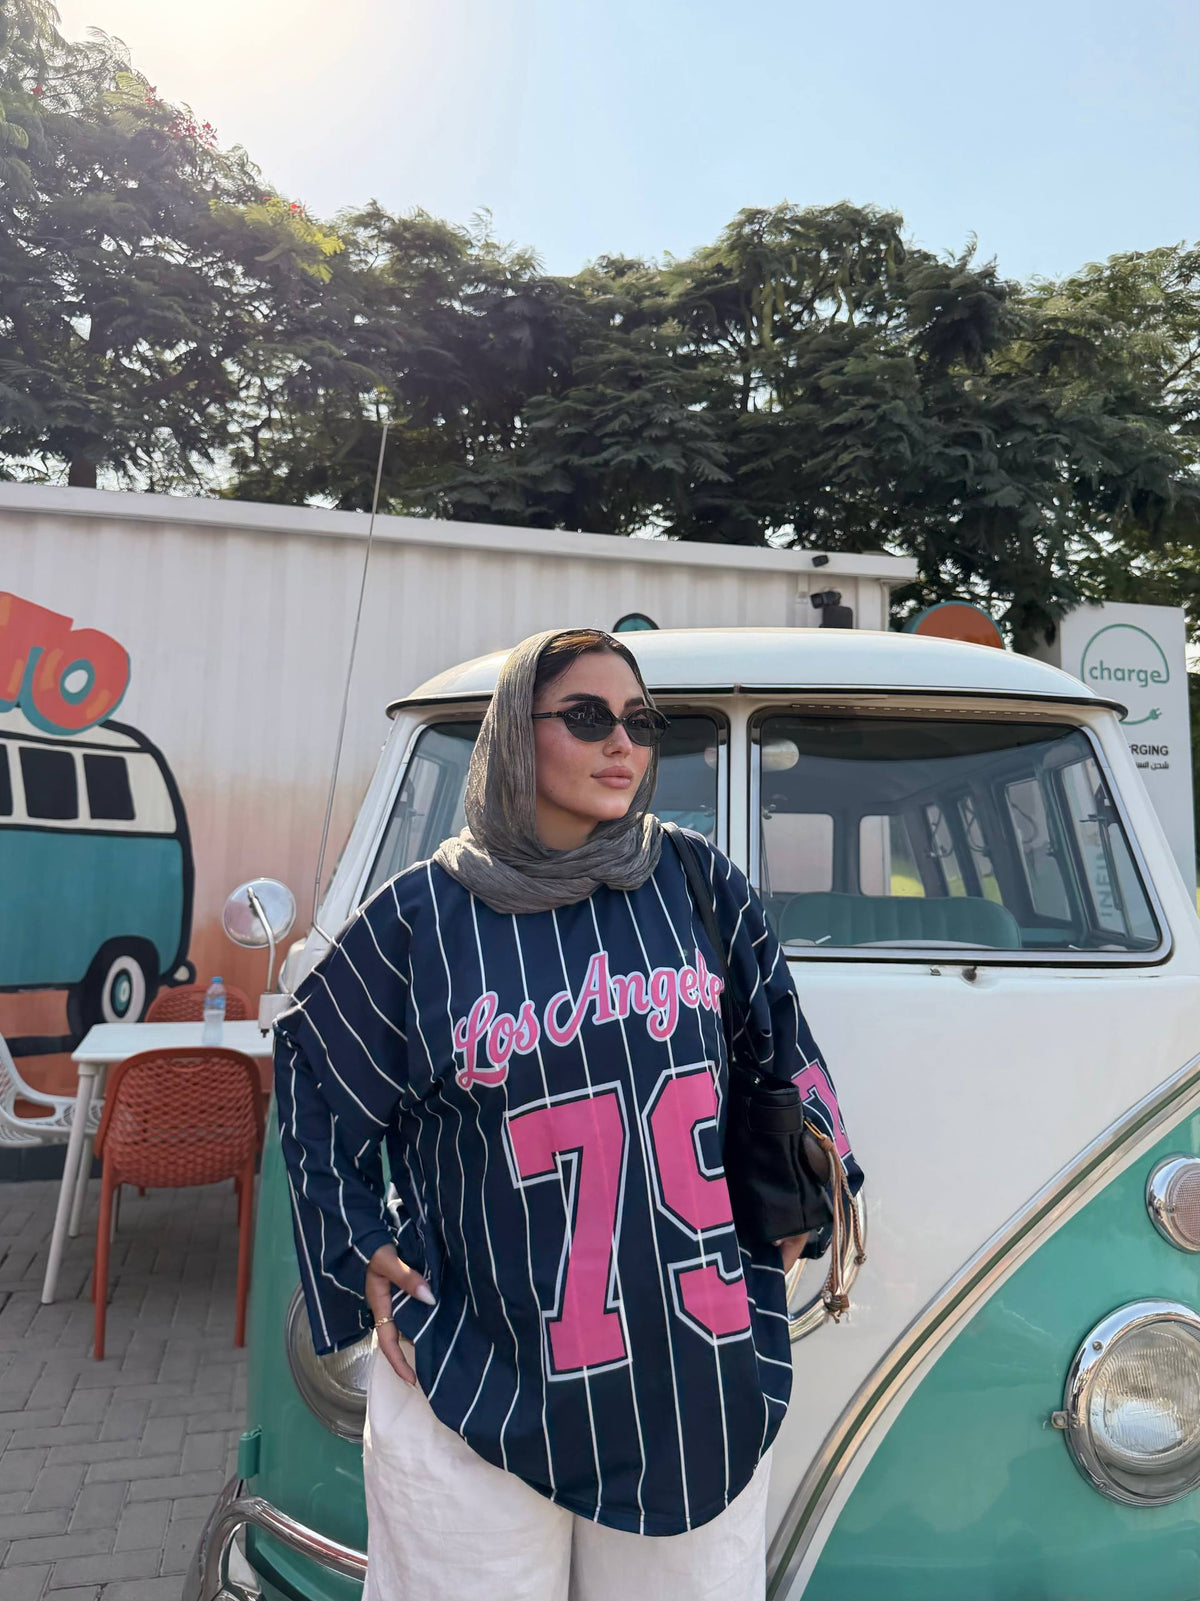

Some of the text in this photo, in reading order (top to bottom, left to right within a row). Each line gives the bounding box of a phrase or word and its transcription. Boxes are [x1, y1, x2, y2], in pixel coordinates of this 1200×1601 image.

[1088, 659, 1164, 688] charge
[1128, 743, 1169, 756] RGING
[453, 948, 725, 1091] Los Angele
